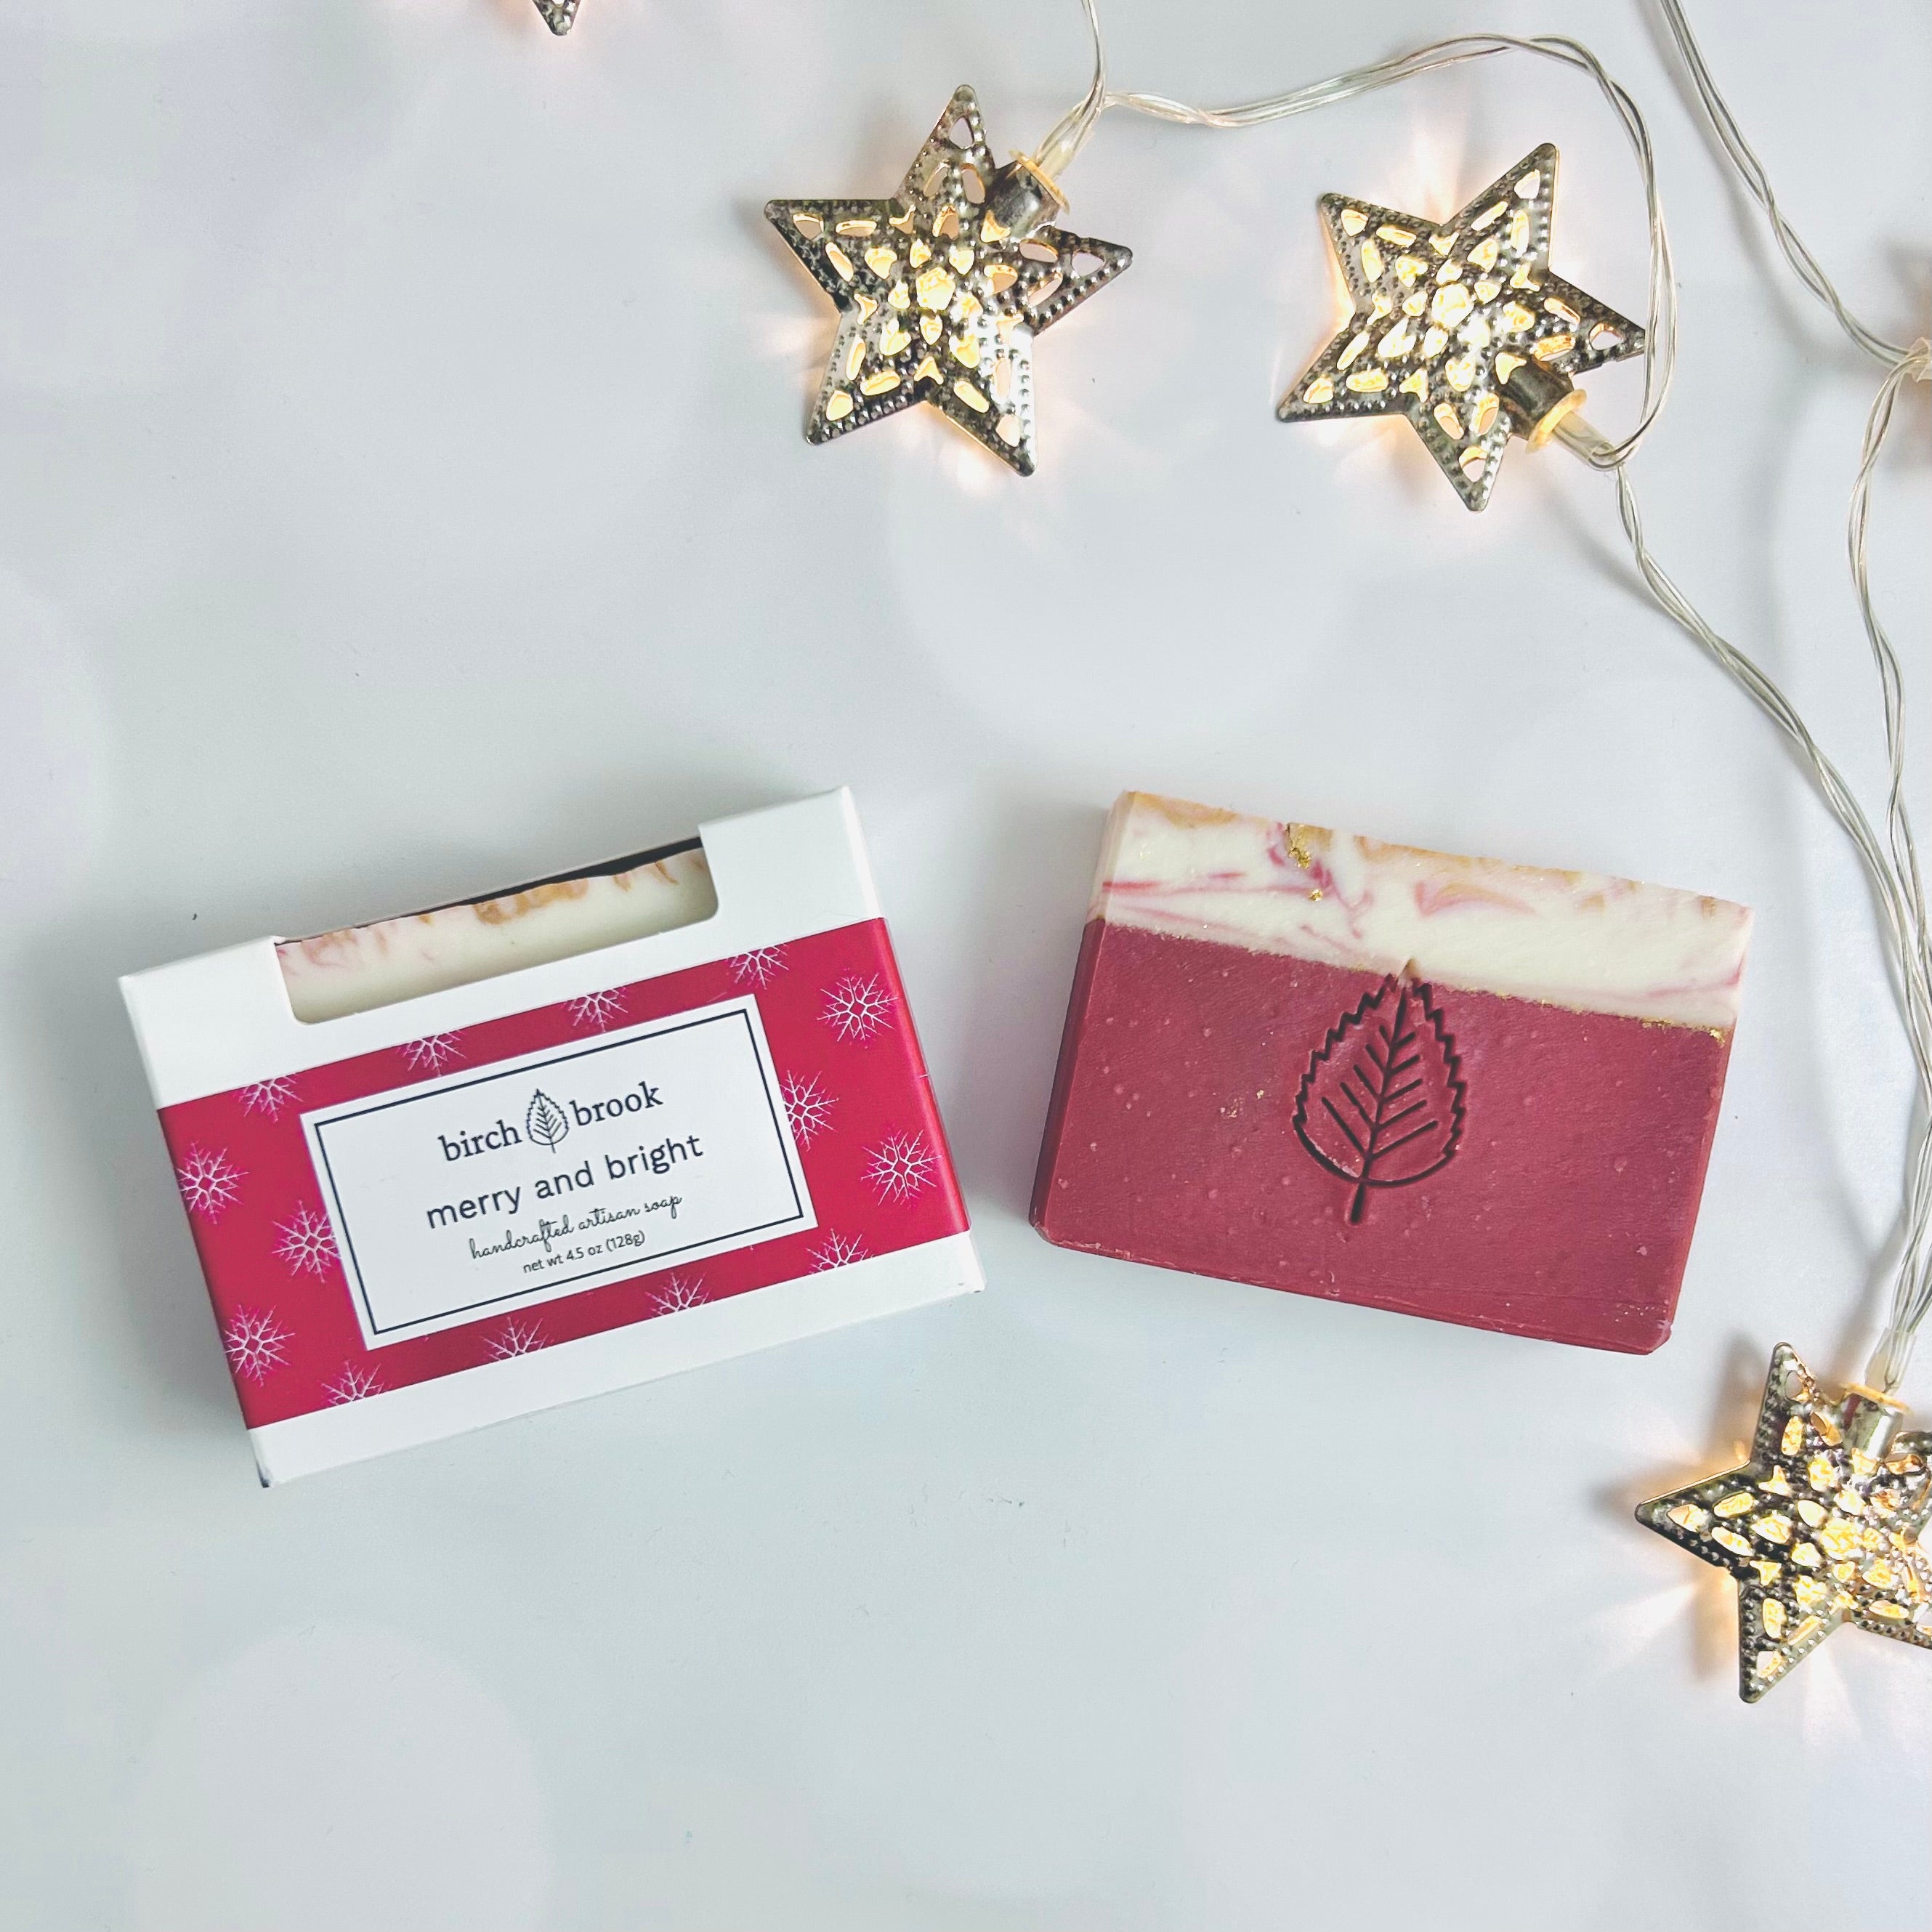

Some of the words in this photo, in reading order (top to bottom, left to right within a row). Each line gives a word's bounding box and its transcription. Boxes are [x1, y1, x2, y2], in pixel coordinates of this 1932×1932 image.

[437, 1119, 523, 1162] birch
[568, 1080, 664, 1126] brook
[427, 1186, 521, 1229] merry
[534, 1160, 595, 1200] and
[604, 1134, 704, 1180] bright
[469, 1214, 575, 1260] handcrafted
[578, 1208, 641, 1230] artisan
[644, 1195, 683, 1220] soap
[522, 1258, 545, 1274] net
[546, 1253, 565, 1267] wt
[587, 1245, 603, 1256] oz
[605, 1229, 645, 1253] (128g)
